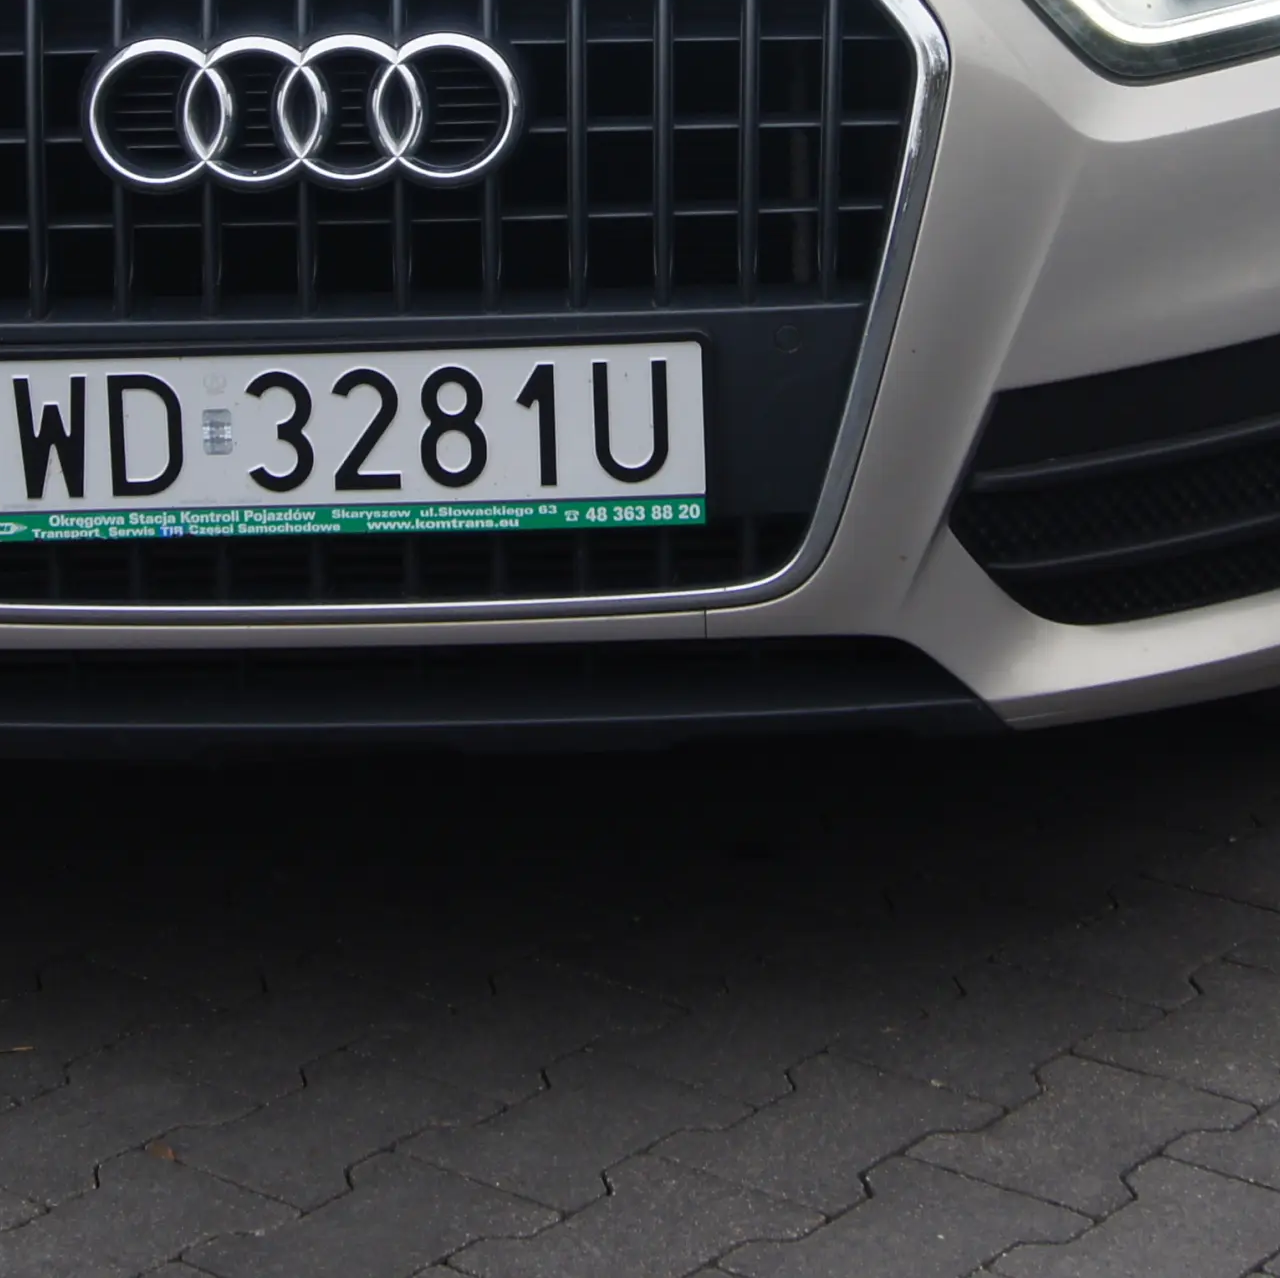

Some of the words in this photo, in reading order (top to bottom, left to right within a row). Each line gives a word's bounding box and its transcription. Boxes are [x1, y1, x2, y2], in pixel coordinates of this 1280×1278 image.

[11, 372, 184, 500] WD
[243, 358, 670, 493] 3281U
[129, 512, 176, 527] Stacja
[180, 509, 240, 524] Kontroli
[244, 509, 316, 524] Pojazdów
[331, 508, 411, 520] Skaryszew
[538, 505, 558, 515] 63
[586, 507, 608, 522] 48
[613, 505, 646, 522] 363
[651, 505, 673, 521] 88
[678, 504, 701, 520] 20
[108, 526, 156, 539] Serwis
[238, 522, 341, 535] Samochodowe
[367, 518, 519, 531] www.komtrans.eu
